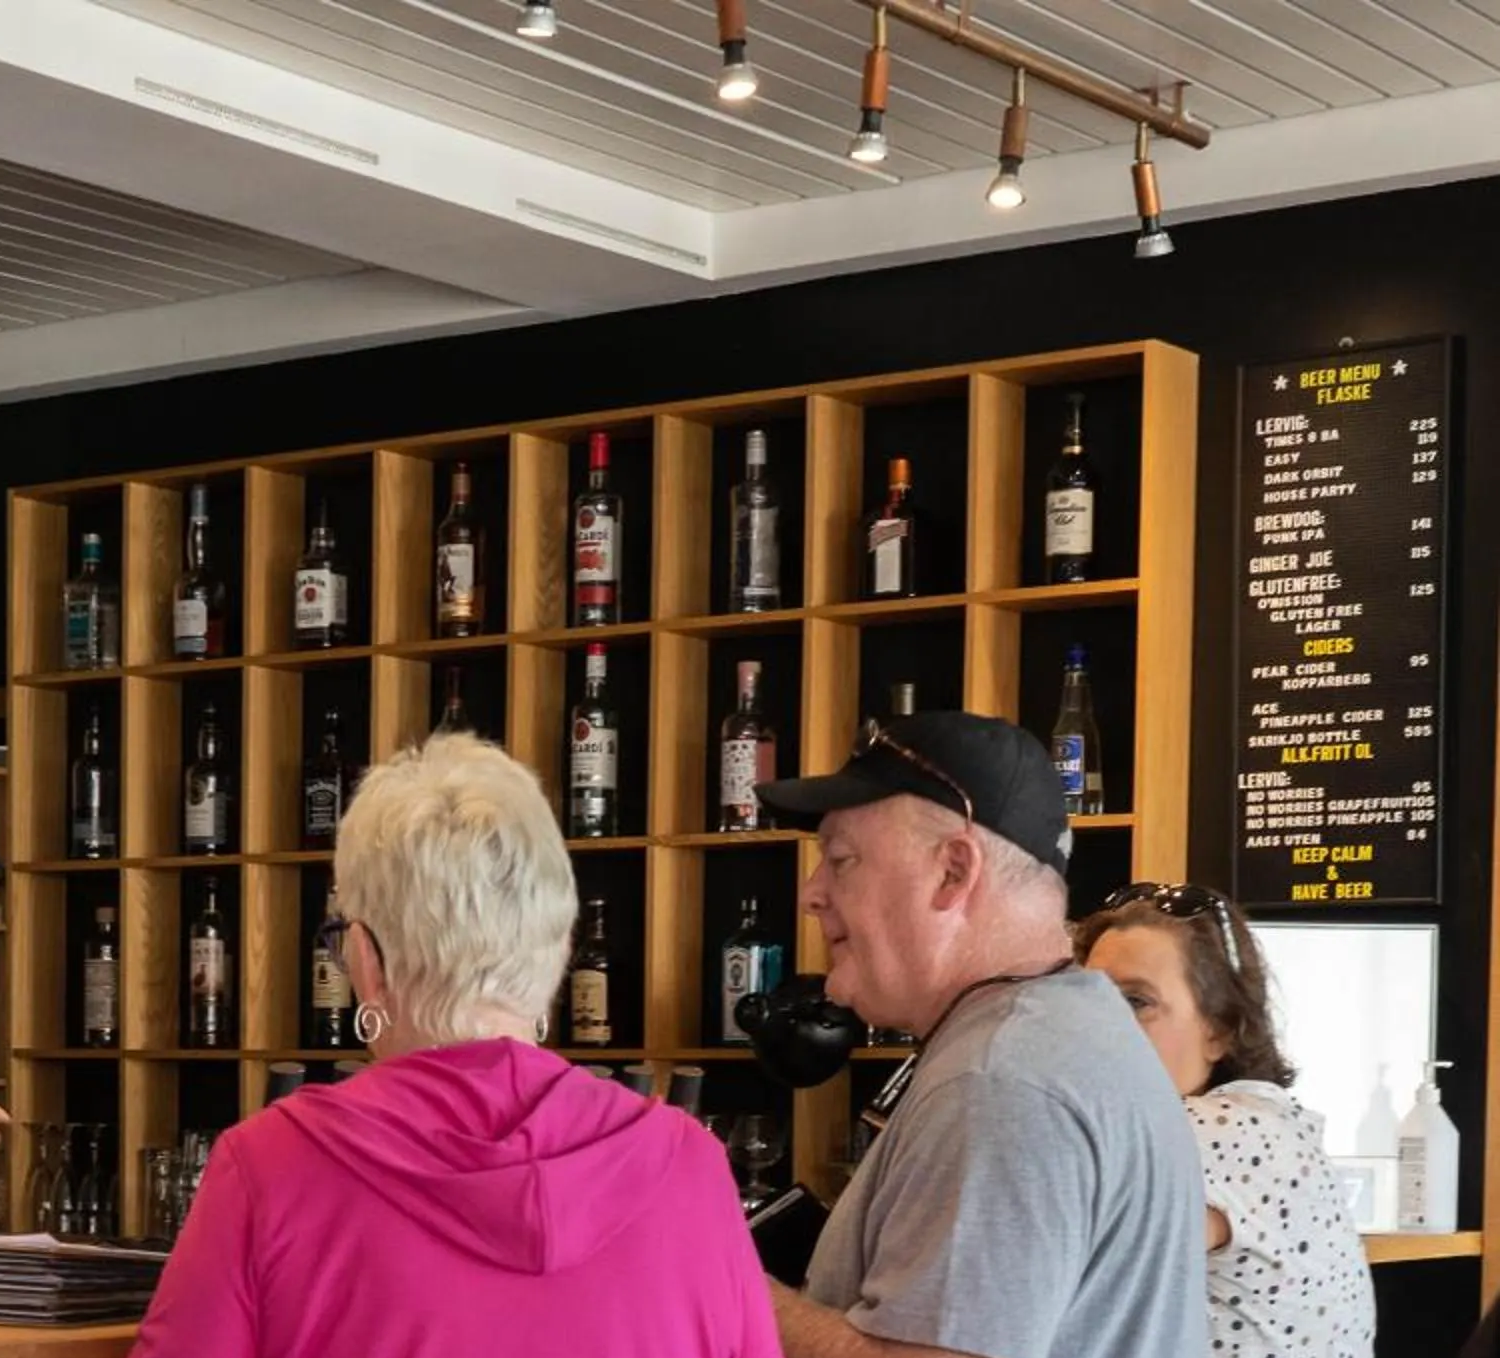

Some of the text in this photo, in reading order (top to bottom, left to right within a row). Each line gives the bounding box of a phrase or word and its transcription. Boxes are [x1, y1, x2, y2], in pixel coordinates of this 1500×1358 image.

[1300, 363, 1381, 389] BEER MENU
[1317, 383, 1372, 405] FLASKE
[1264, 433, 1303, 448] TIMES
[1409, 417, 1438, 432] 225
[1264, 452, 1300, 467] EASY
[1264, 451, 1438, 485] DARK ORBIT 137
[1264, 488, 1308, 504] HOUSE
[1311, 483, 1357, 498] PARTY
[1255, 510, 1325, 532] BREWDOG:
[1263, 530, 1299, 545] PUNK
[1302, 528, 1325, 542] IPA
[1250, 553, 1299, 574] GINGER
[1305, 550, 1333, 569] JOE
[1270, 604, 1363, 622] GLUTEN FREE
[1295, 620, 1341, 634] LAGER
[1303, 637, 1354, 656] CIDERS
[1252, 665, 1288, 680] PEAR
[1295, 662, 1336, 676] CIDER
[1282, 673, 1372, 690] KOPPARBERG
[1260, 706, 1433, 729] PINEAPPLE CIDER 125
[1307, 729, 1361, 744] BOTTLE
[1247, 791, 1265, 803] NO
[1268, 787, 1325, 801] WORRIES
[1246, 805, 1264, 816] NO
[1268, 801, 1324, 814] WORRIES
[1246, 810, 1435, 830] NO WORRIES PINEAPPLE 105
[1246, 836, 1281, 848] AASS
[1284, 834, 1321, 846] UTEN
[1293, 845, 1373, 864] KEEP CALM
[1326, 865, 1339, 880] &
[1292, 882, 1373, 900] HAVE BEER
